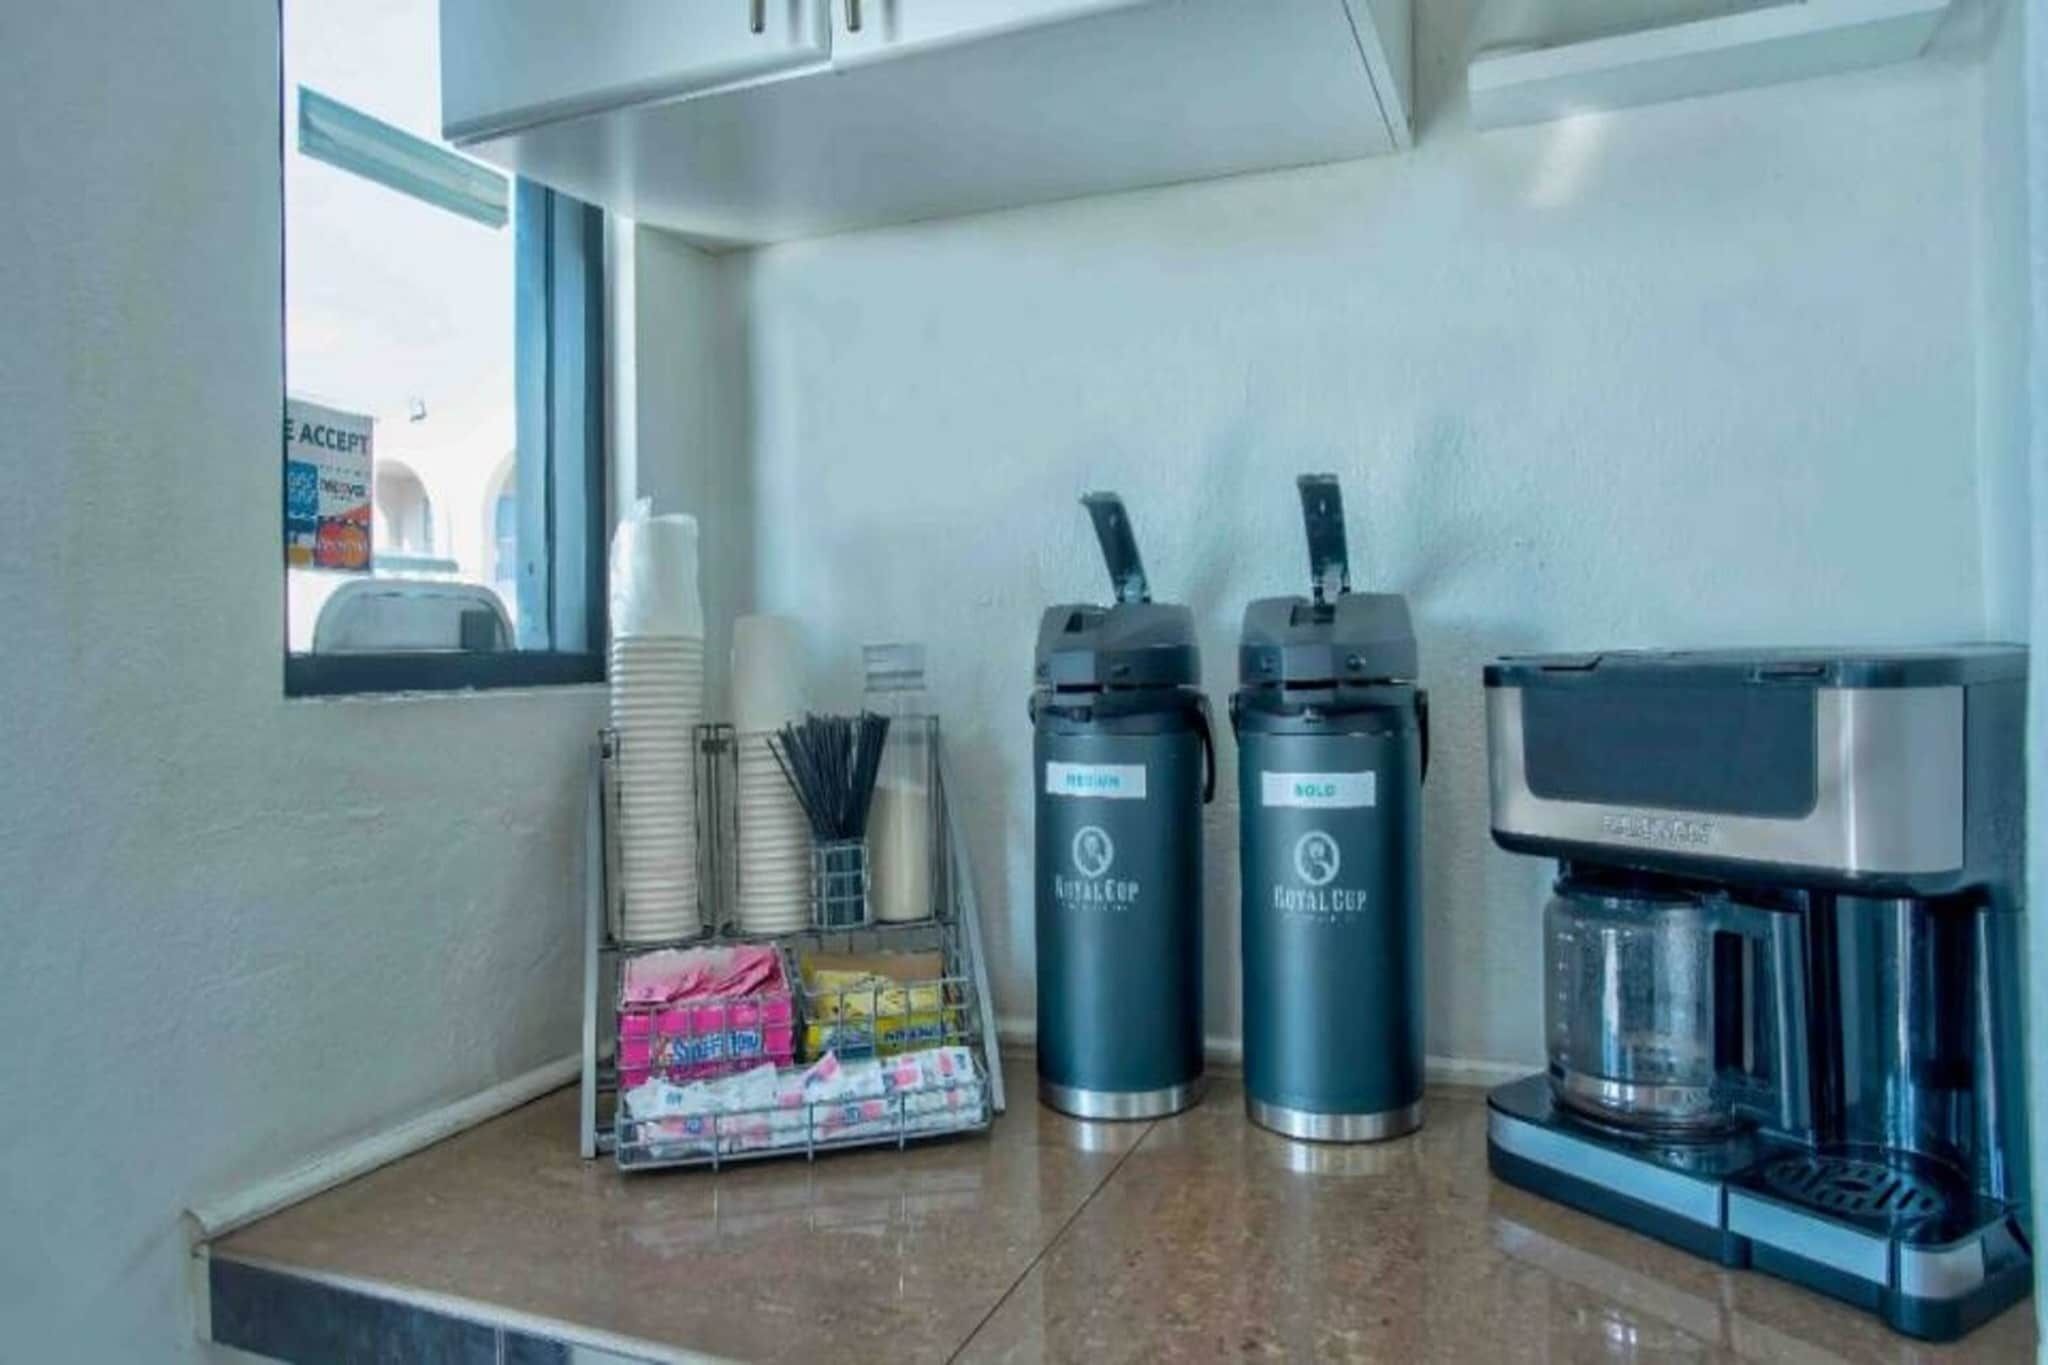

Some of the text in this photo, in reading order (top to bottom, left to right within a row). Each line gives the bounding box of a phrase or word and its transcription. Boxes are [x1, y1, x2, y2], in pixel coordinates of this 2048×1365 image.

[299, 423, 369, 454] ACCEPT
[1274, 884, 1367, 912] ROYAL CUP
